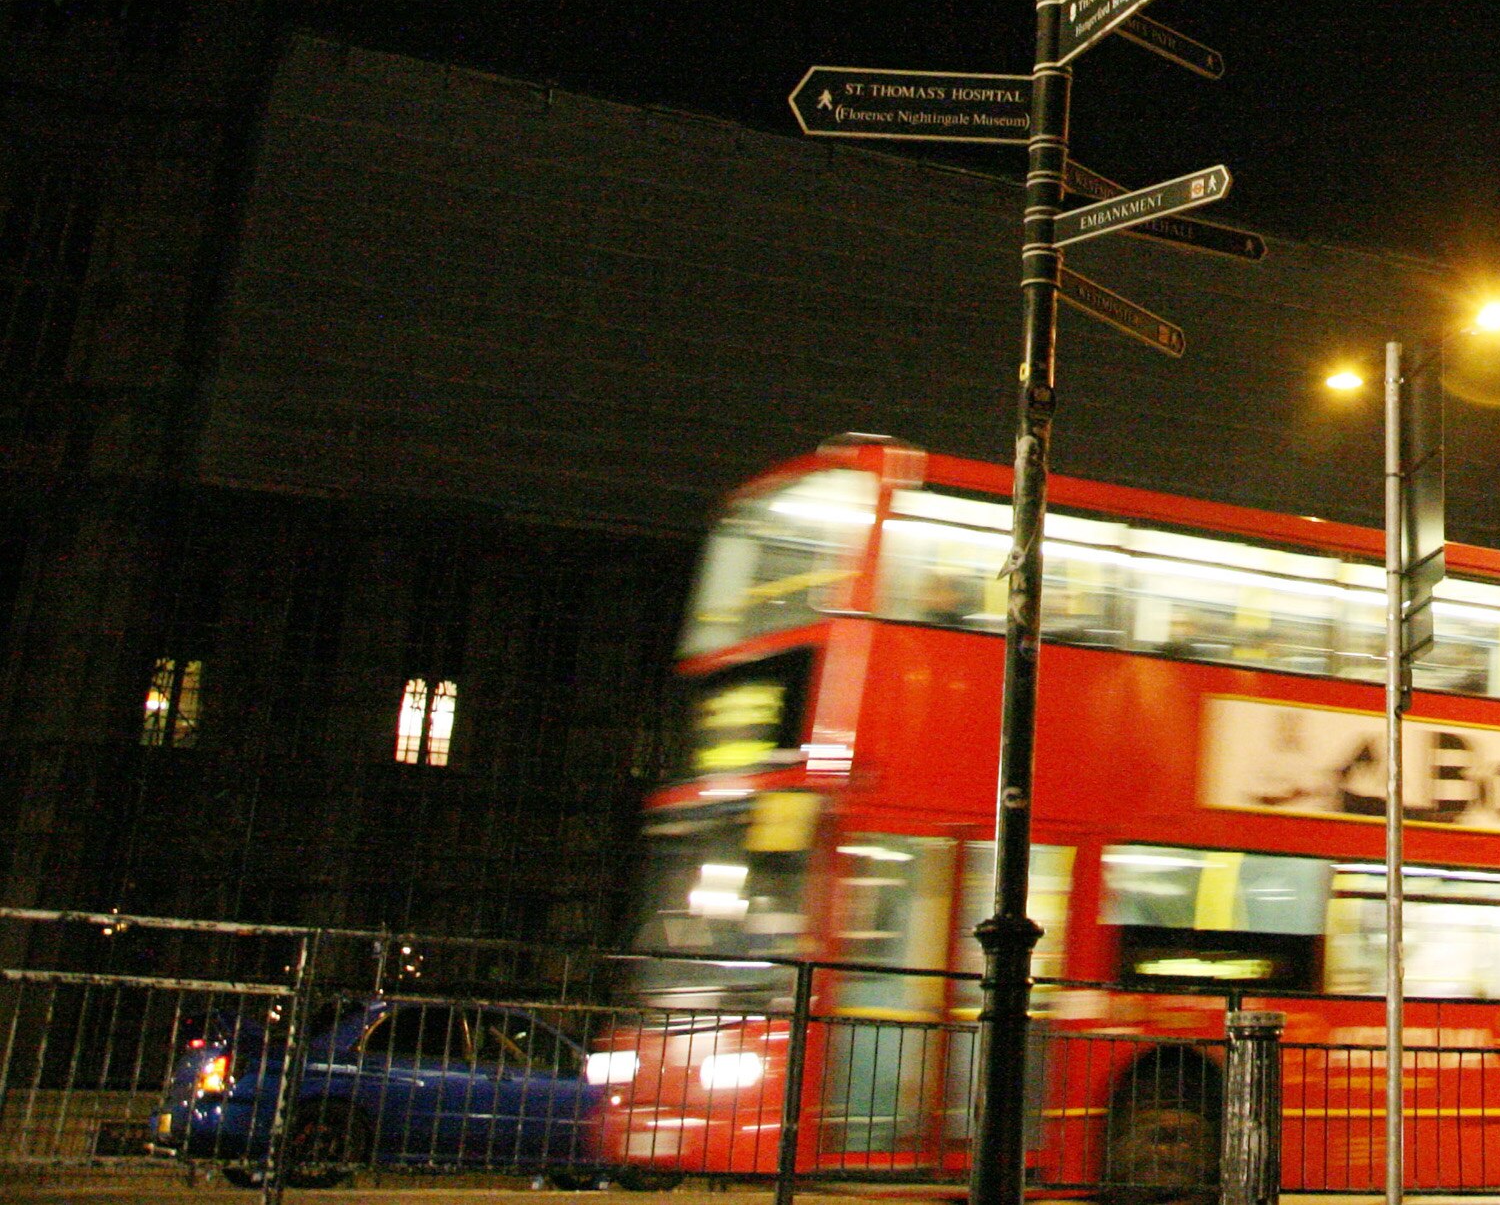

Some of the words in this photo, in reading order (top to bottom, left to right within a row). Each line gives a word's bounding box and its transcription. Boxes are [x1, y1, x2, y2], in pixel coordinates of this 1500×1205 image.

[952, 88, 1025, 103] HOSPITAL
[835, 103, 894, 124] (Florence
[898, 110, 970, 127] Nightingale
[973, 112, 1032, 131] Museum)
[1079, 194, 1164, 231] EMBANKMENT
